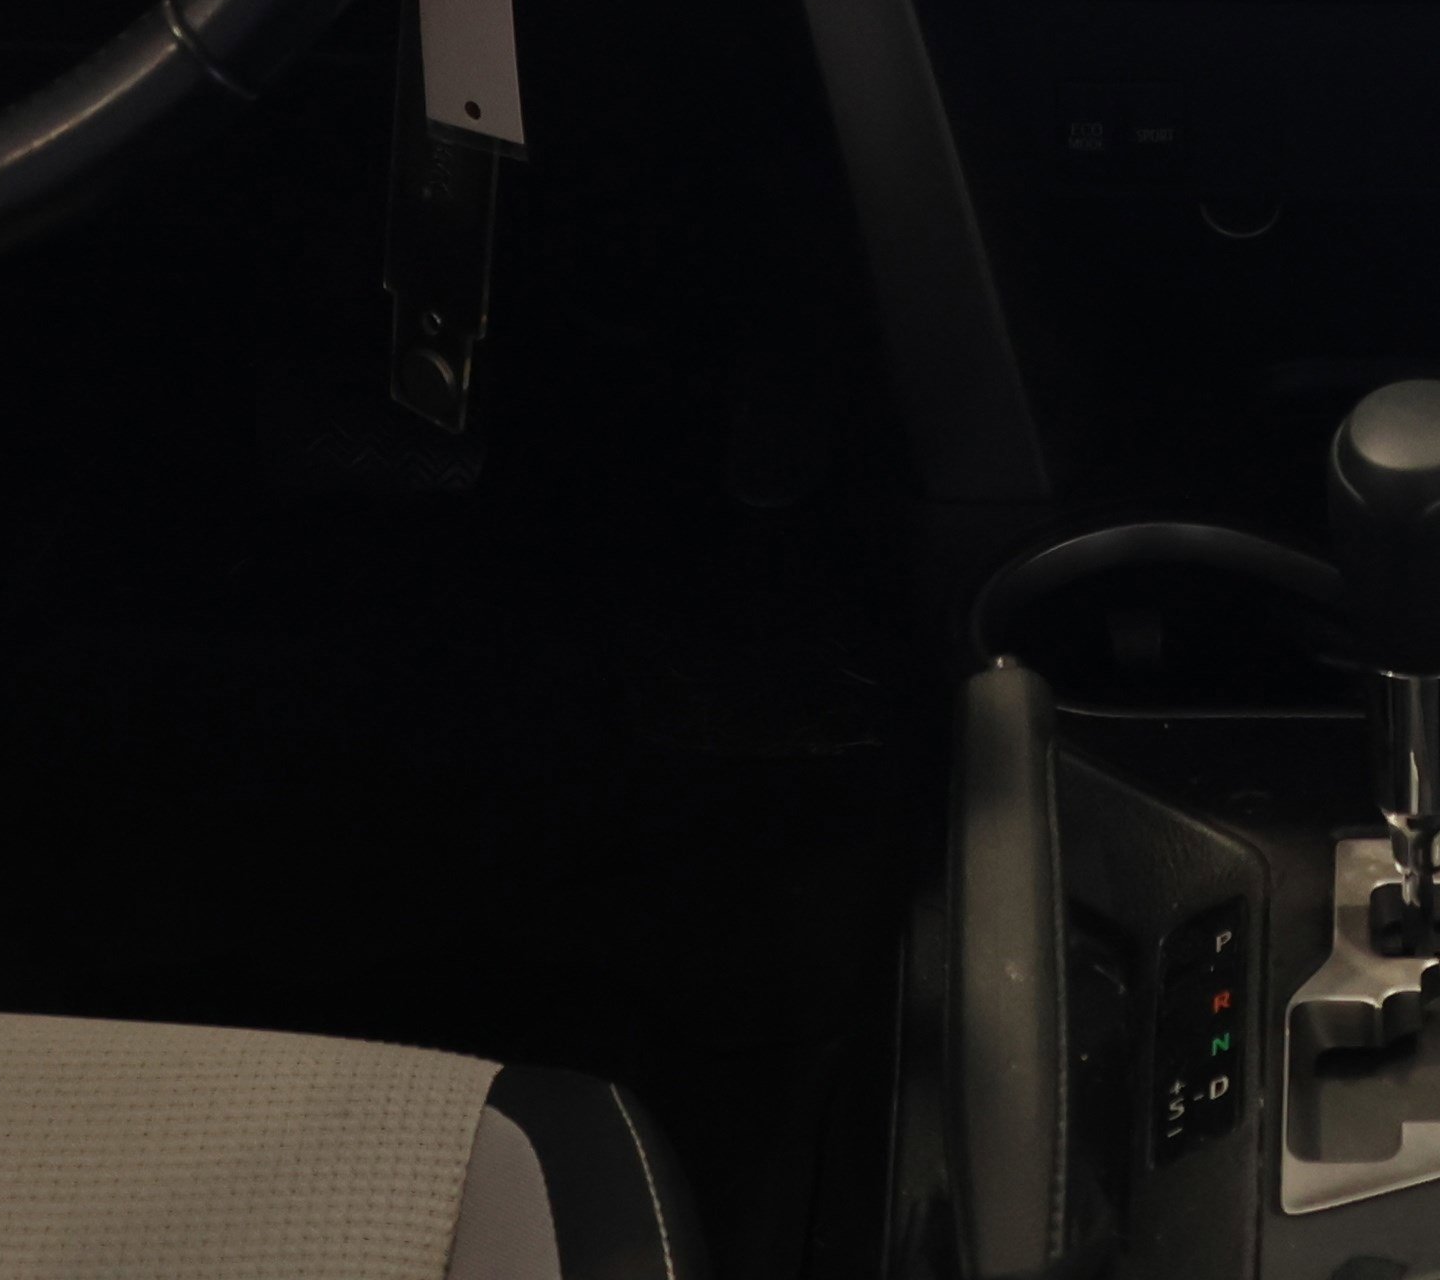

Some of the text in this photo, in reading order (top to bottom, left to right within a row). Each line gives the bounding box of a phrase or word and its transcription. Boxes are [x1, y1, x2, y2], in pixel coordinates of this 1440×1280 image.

[1216, 931, 1232, 953] P
[1212, 991, 1230, 1013] R
[1211, 1033, 1230, 1056] N
[1209, 1075, 1229, 1099] D
[1168, 1098, 1185, 1118] S
